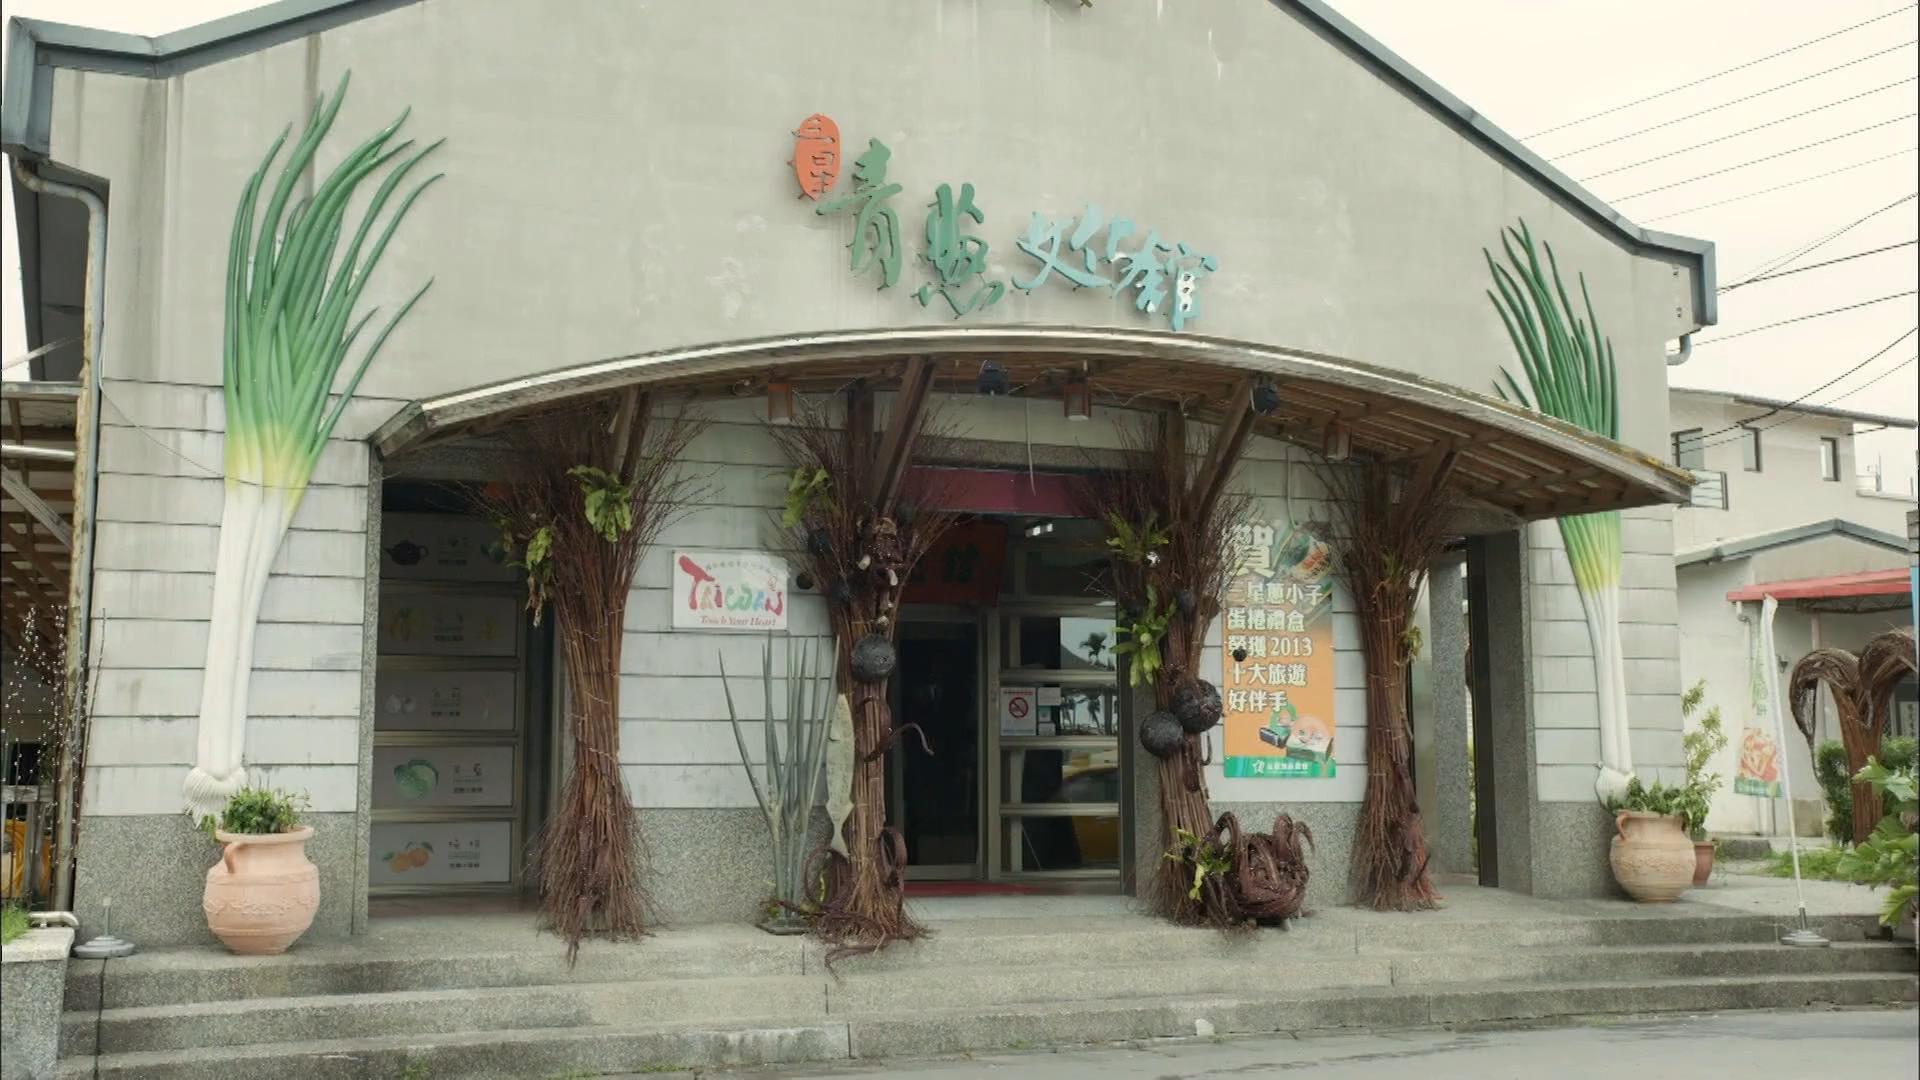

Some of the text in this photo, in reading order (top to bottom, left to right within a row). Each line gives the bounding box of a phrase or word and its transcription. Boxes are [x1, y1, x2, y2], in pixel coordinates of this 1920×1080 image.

[1226, 524, 1276, 579] 賀
[1229, 663, 1307, 687] 十大旅遊
[1228, 689, 1288, 713] 好伴手
